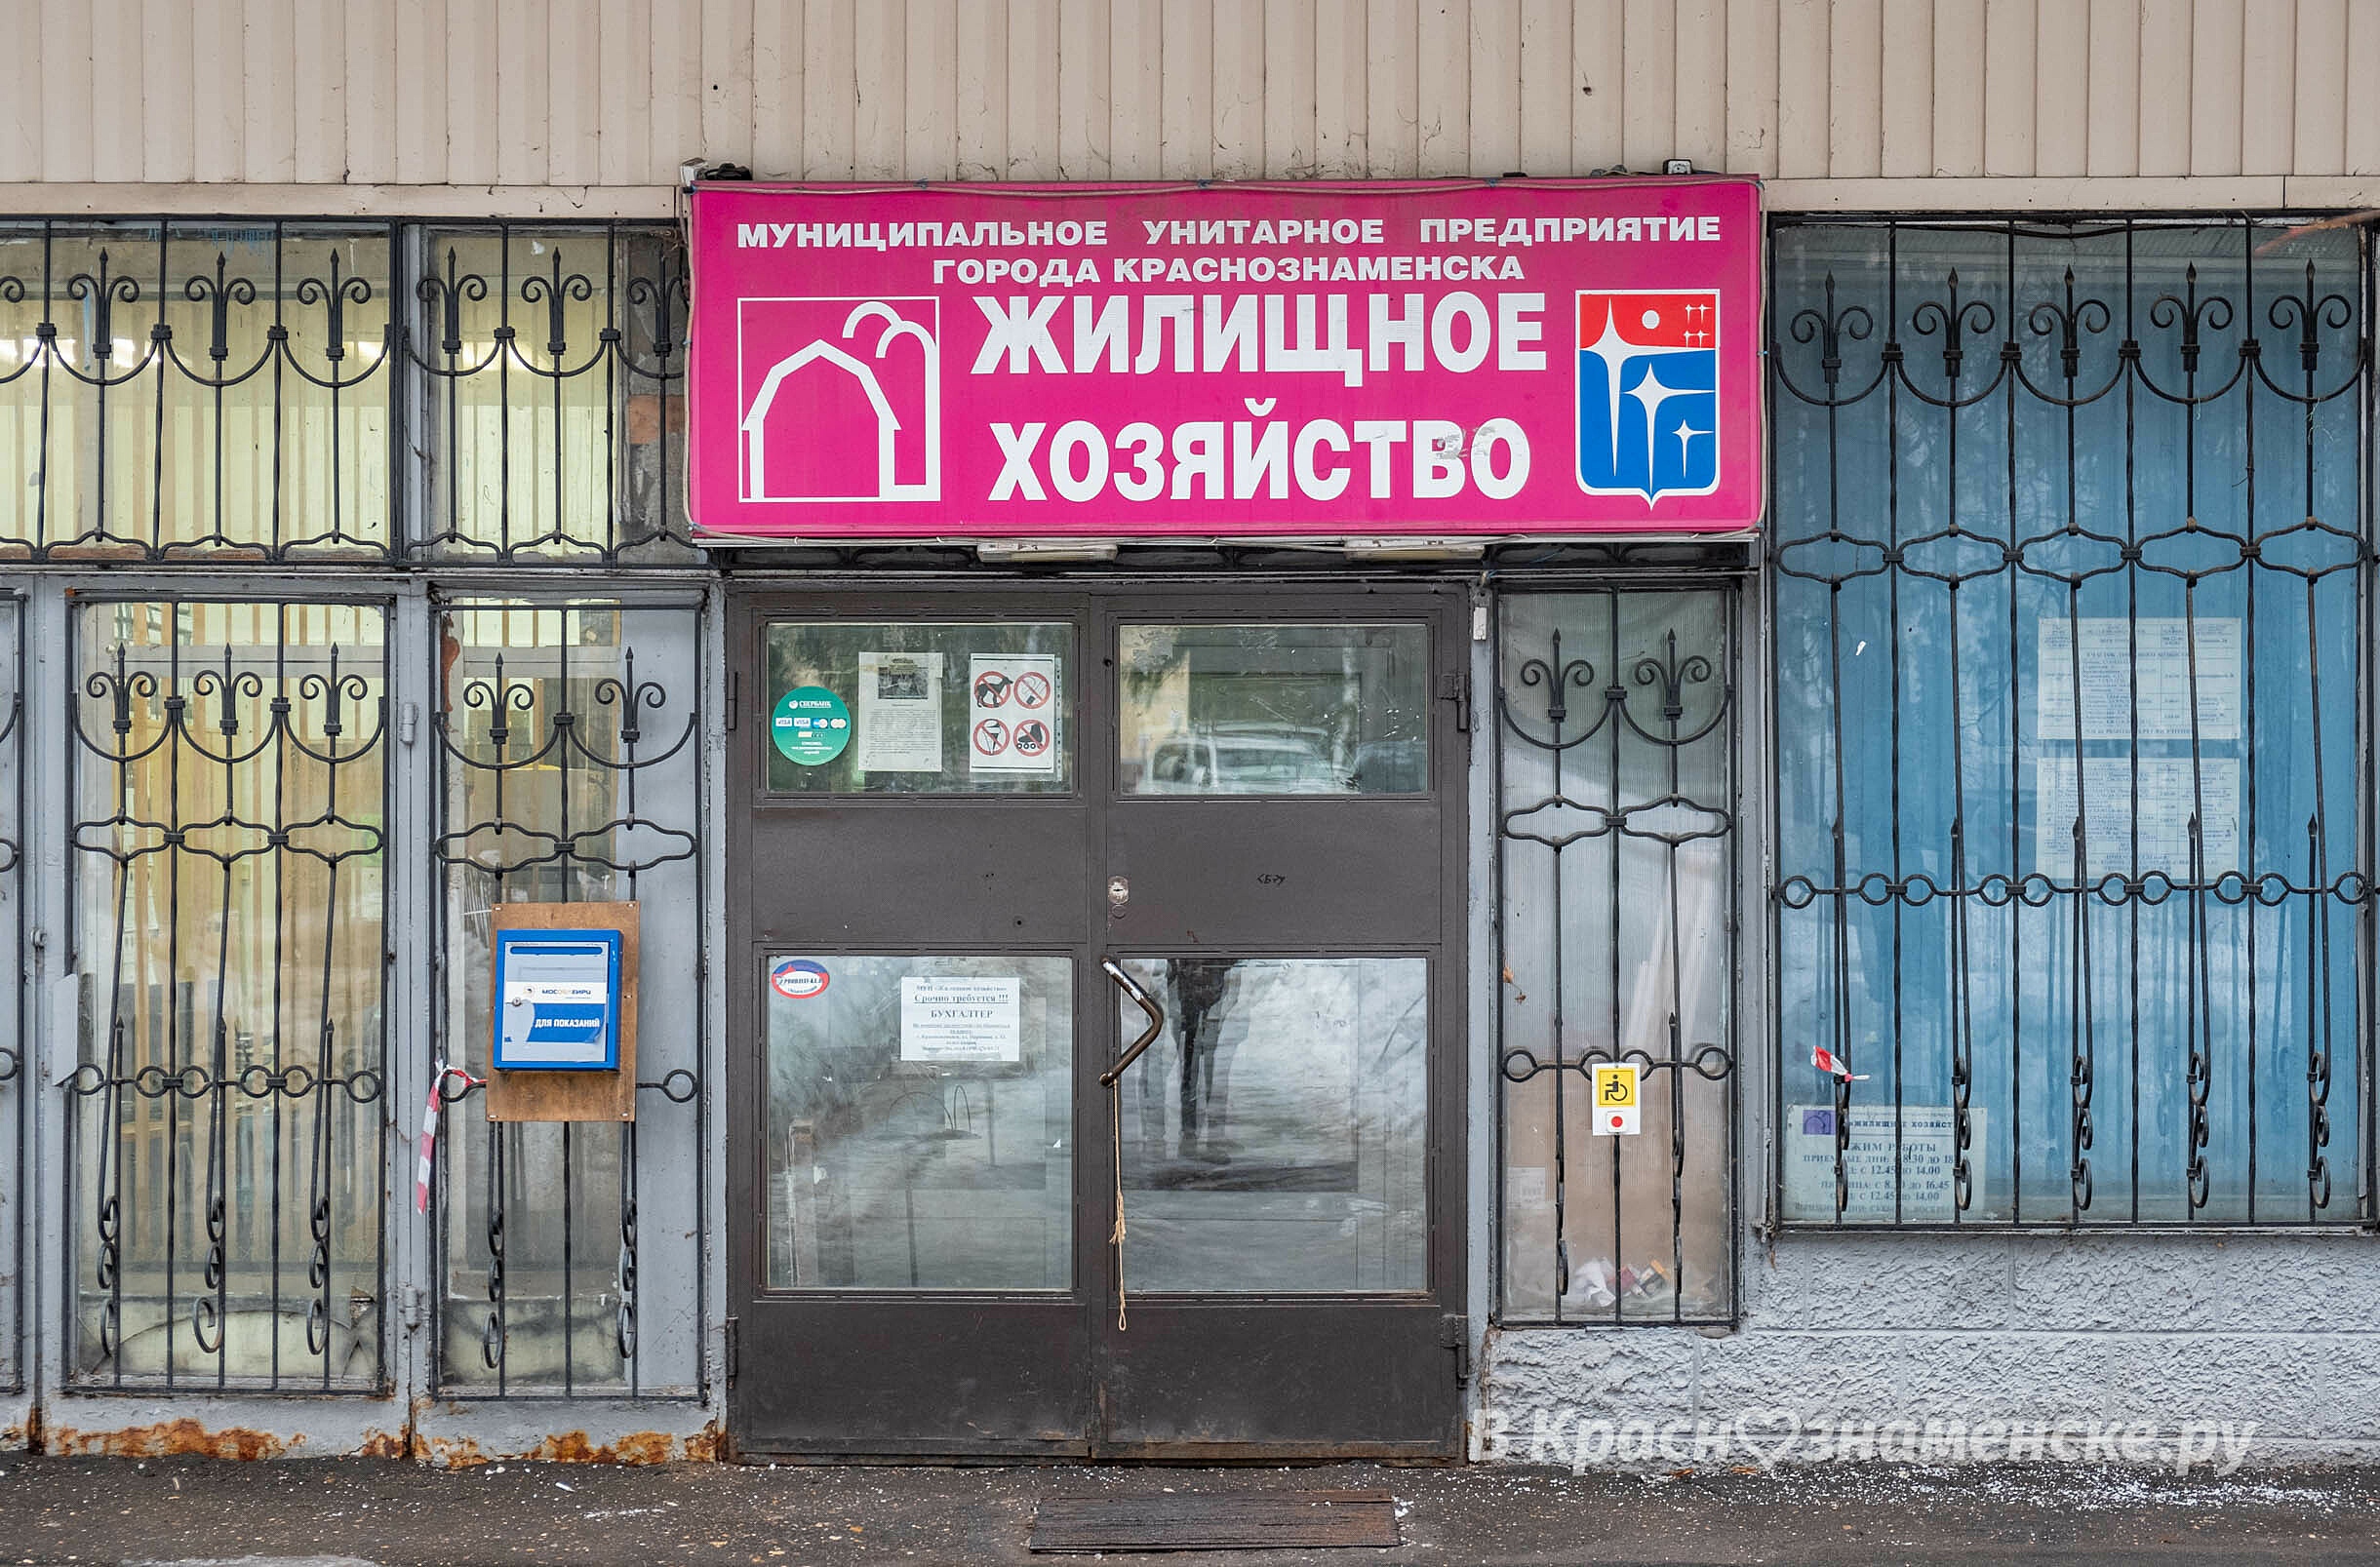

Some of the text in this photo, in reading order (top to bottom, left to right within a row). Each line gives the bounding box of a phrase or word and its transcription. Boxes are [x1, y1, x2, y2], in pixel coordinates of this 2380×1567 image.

[738, 216, 1720, 251] МУНИЦИПАЛЬНОЕ УНИТАРНОЕ ПРЕДПРИЯТИЕ
[934, 256, 1525, 287] ГОРОДА КРАСНОЗНАМЕНСКА
[971, 292, 1546, 386] ЖИЛИЩНОЕ
[988, 398, 1529, 501] ХОЗЯЙСТВО
[914, 994, 949, 1003] Срочно
[952, 994, 995, 1003] требуется
[931, 1009, 993, 1019] БУХГАЛТЕР
[535, 1017, 600, 1028] ДЛЯ ПОКАЗАНИЙ
